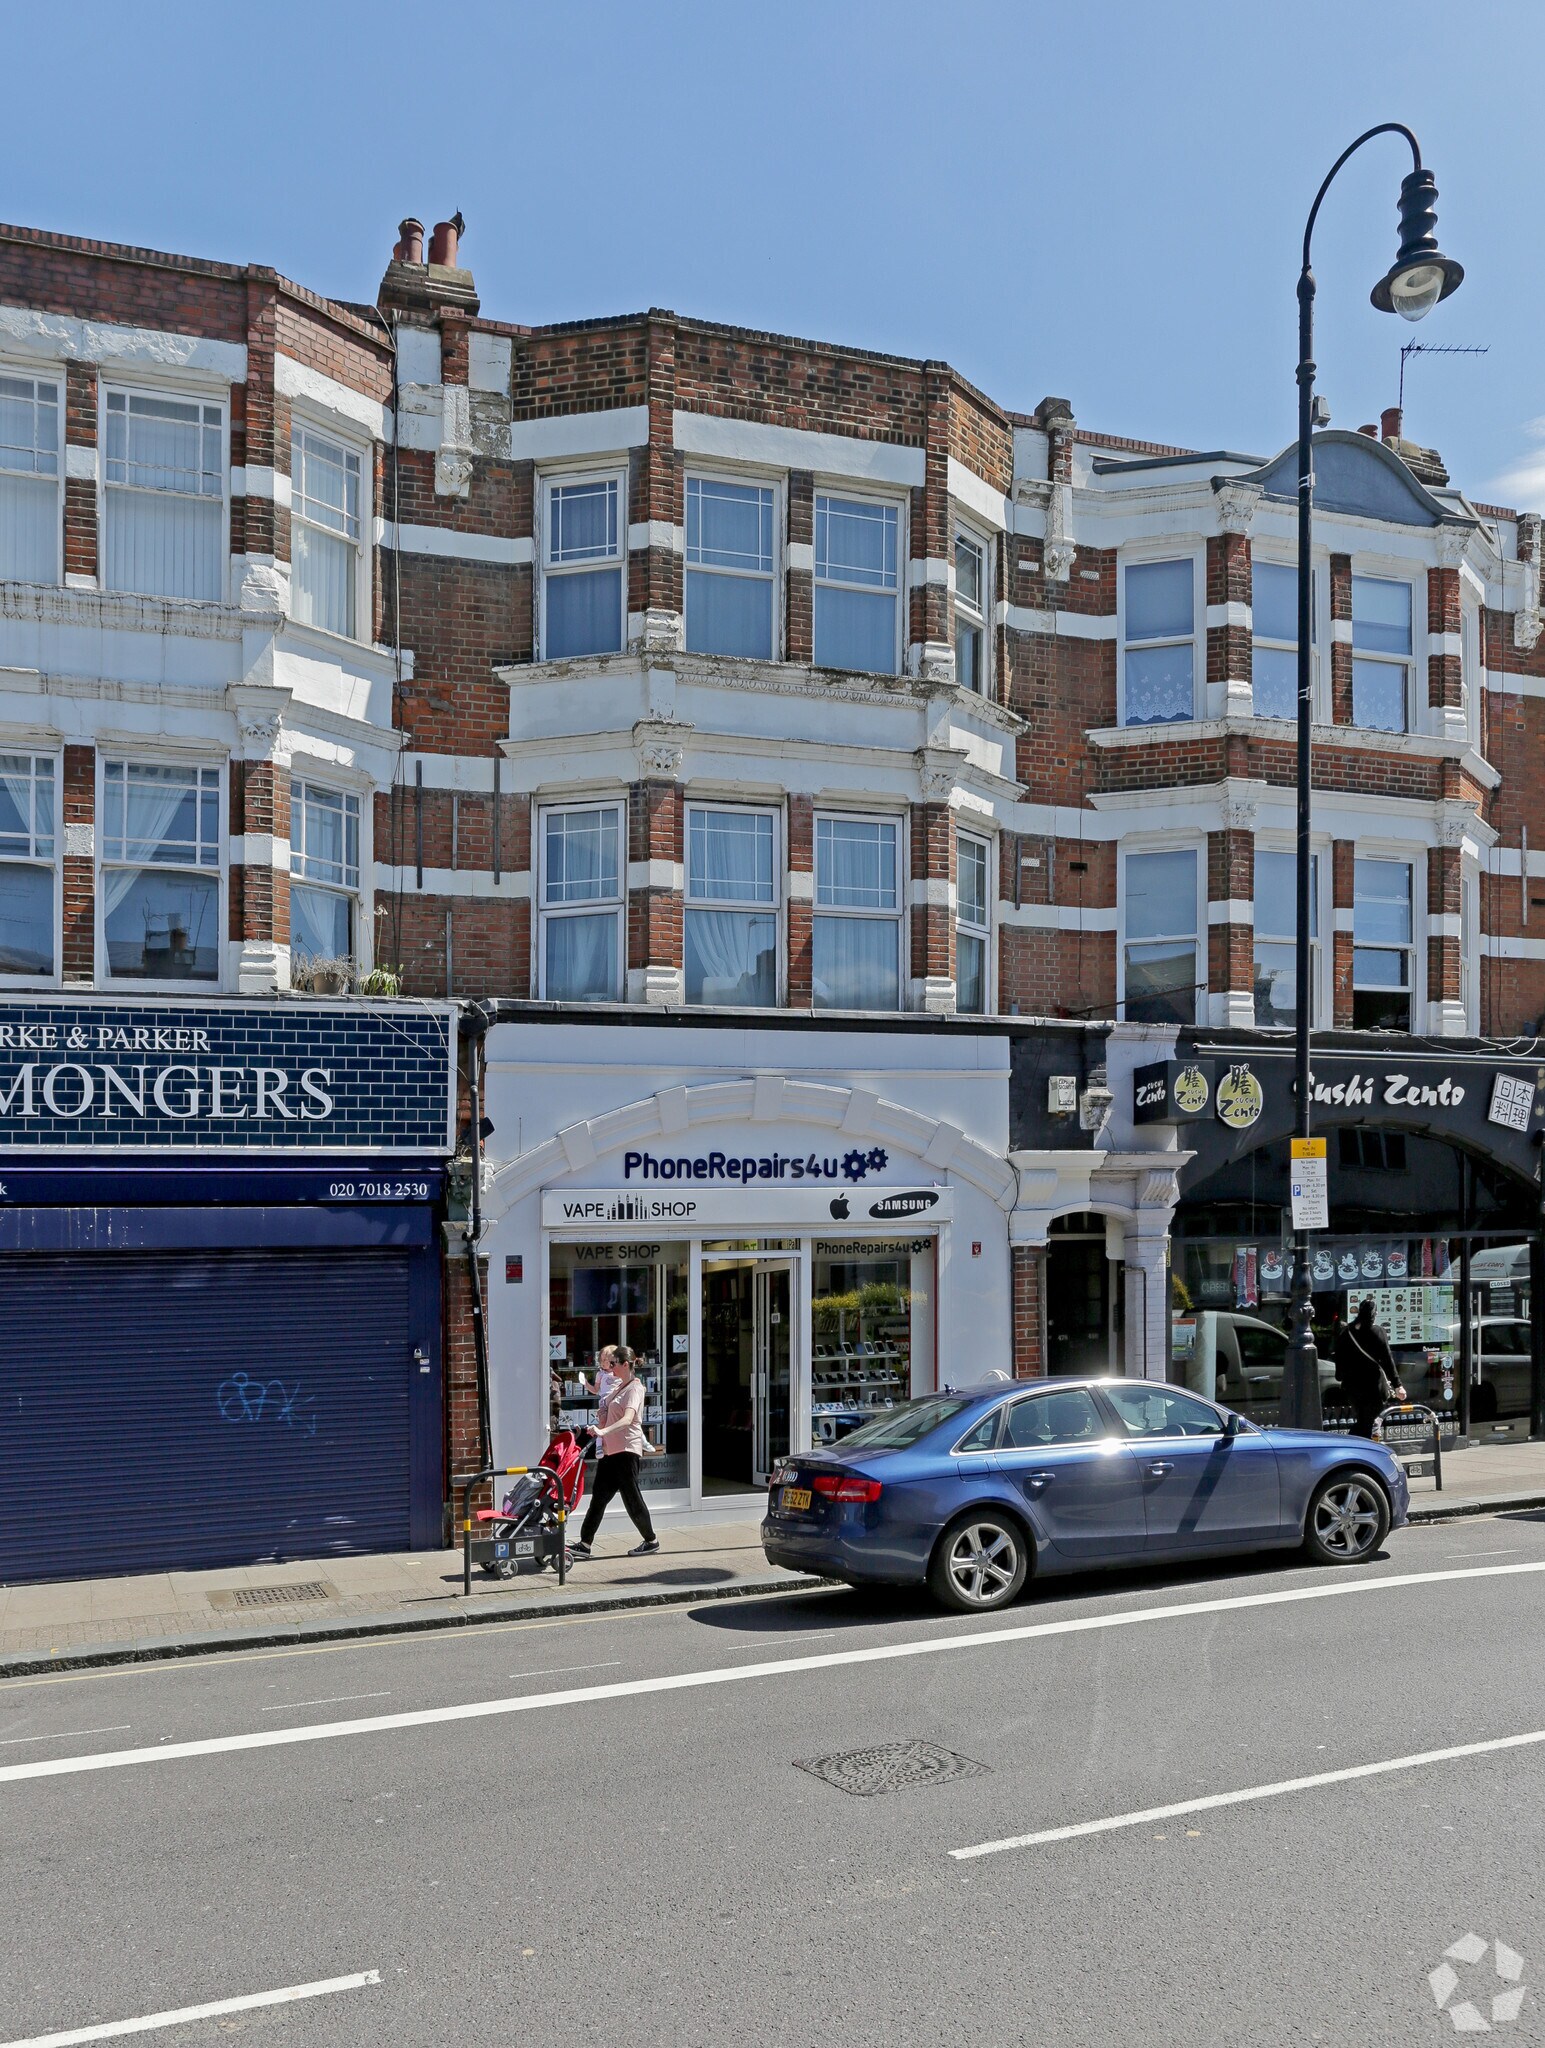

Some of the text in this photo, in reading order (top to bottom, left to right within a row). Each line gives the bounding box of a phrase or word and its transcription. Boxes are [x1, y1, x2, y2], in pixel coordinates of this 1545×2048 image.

[66, 1026, 89, 1049] &
[97, 1027, 211, 1051] PARKER
[0, 1062, 334, 1120] MONGERS
[1136, 1085, 1166, 1107] Zento
[1176, 1091, 1206, 1105] Zento
[1383, 1074, 1465, 1106] Zento
[1500, 1080, 1531, 1104] 日本
[1220, 1099, 1260, 1118] Zento
[1494, 1102, 1527, 1126] 料理
[624, 1151, 838, 1185] PhoneRepairs4u
[329, 1183, 428, 1196] 020 7018 2530
[1294, 1185, 1300, 1196] P
[563, 1202, 697, 1218] VAPE SHOP
[877, 1199, 932, 1211] SAMSUNG
[575, 1244, 660, 1260] VAPE SHOP
[816, 1241, 910, 1256] PhoneRepairs4u
[649, 1476, 679, 1485] VAPING
[498, 1544, 506, 1556] P
